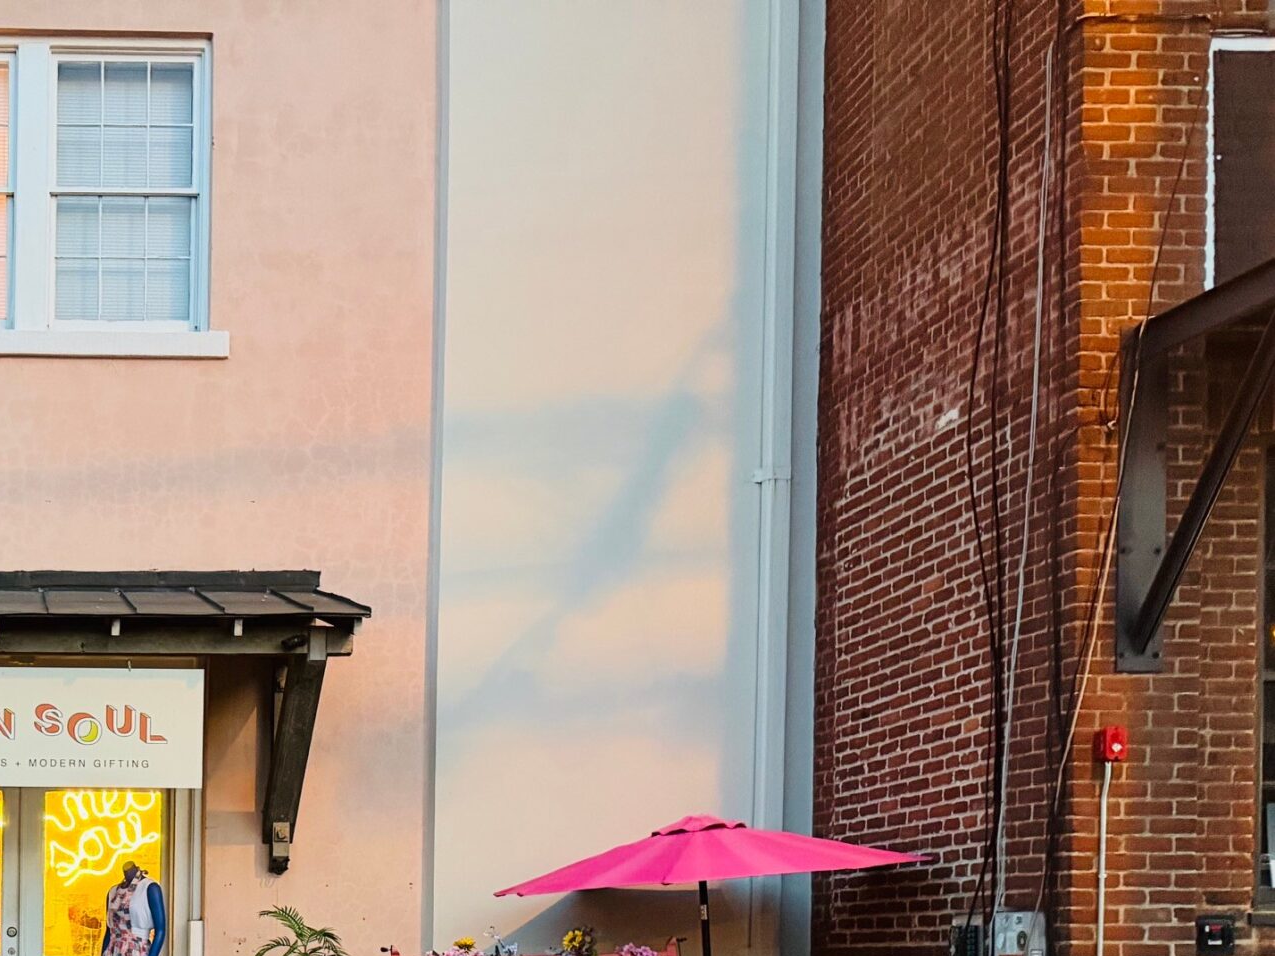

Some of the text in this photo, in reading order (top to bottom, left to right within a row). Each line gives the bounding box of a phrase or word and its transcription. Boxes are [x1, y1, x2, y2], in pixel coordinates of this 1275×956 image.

[34, 703, 168, 745] SOUL
[28, 759, 86, 768] MODERN
[93, 759, 150, 769] GIFTING
